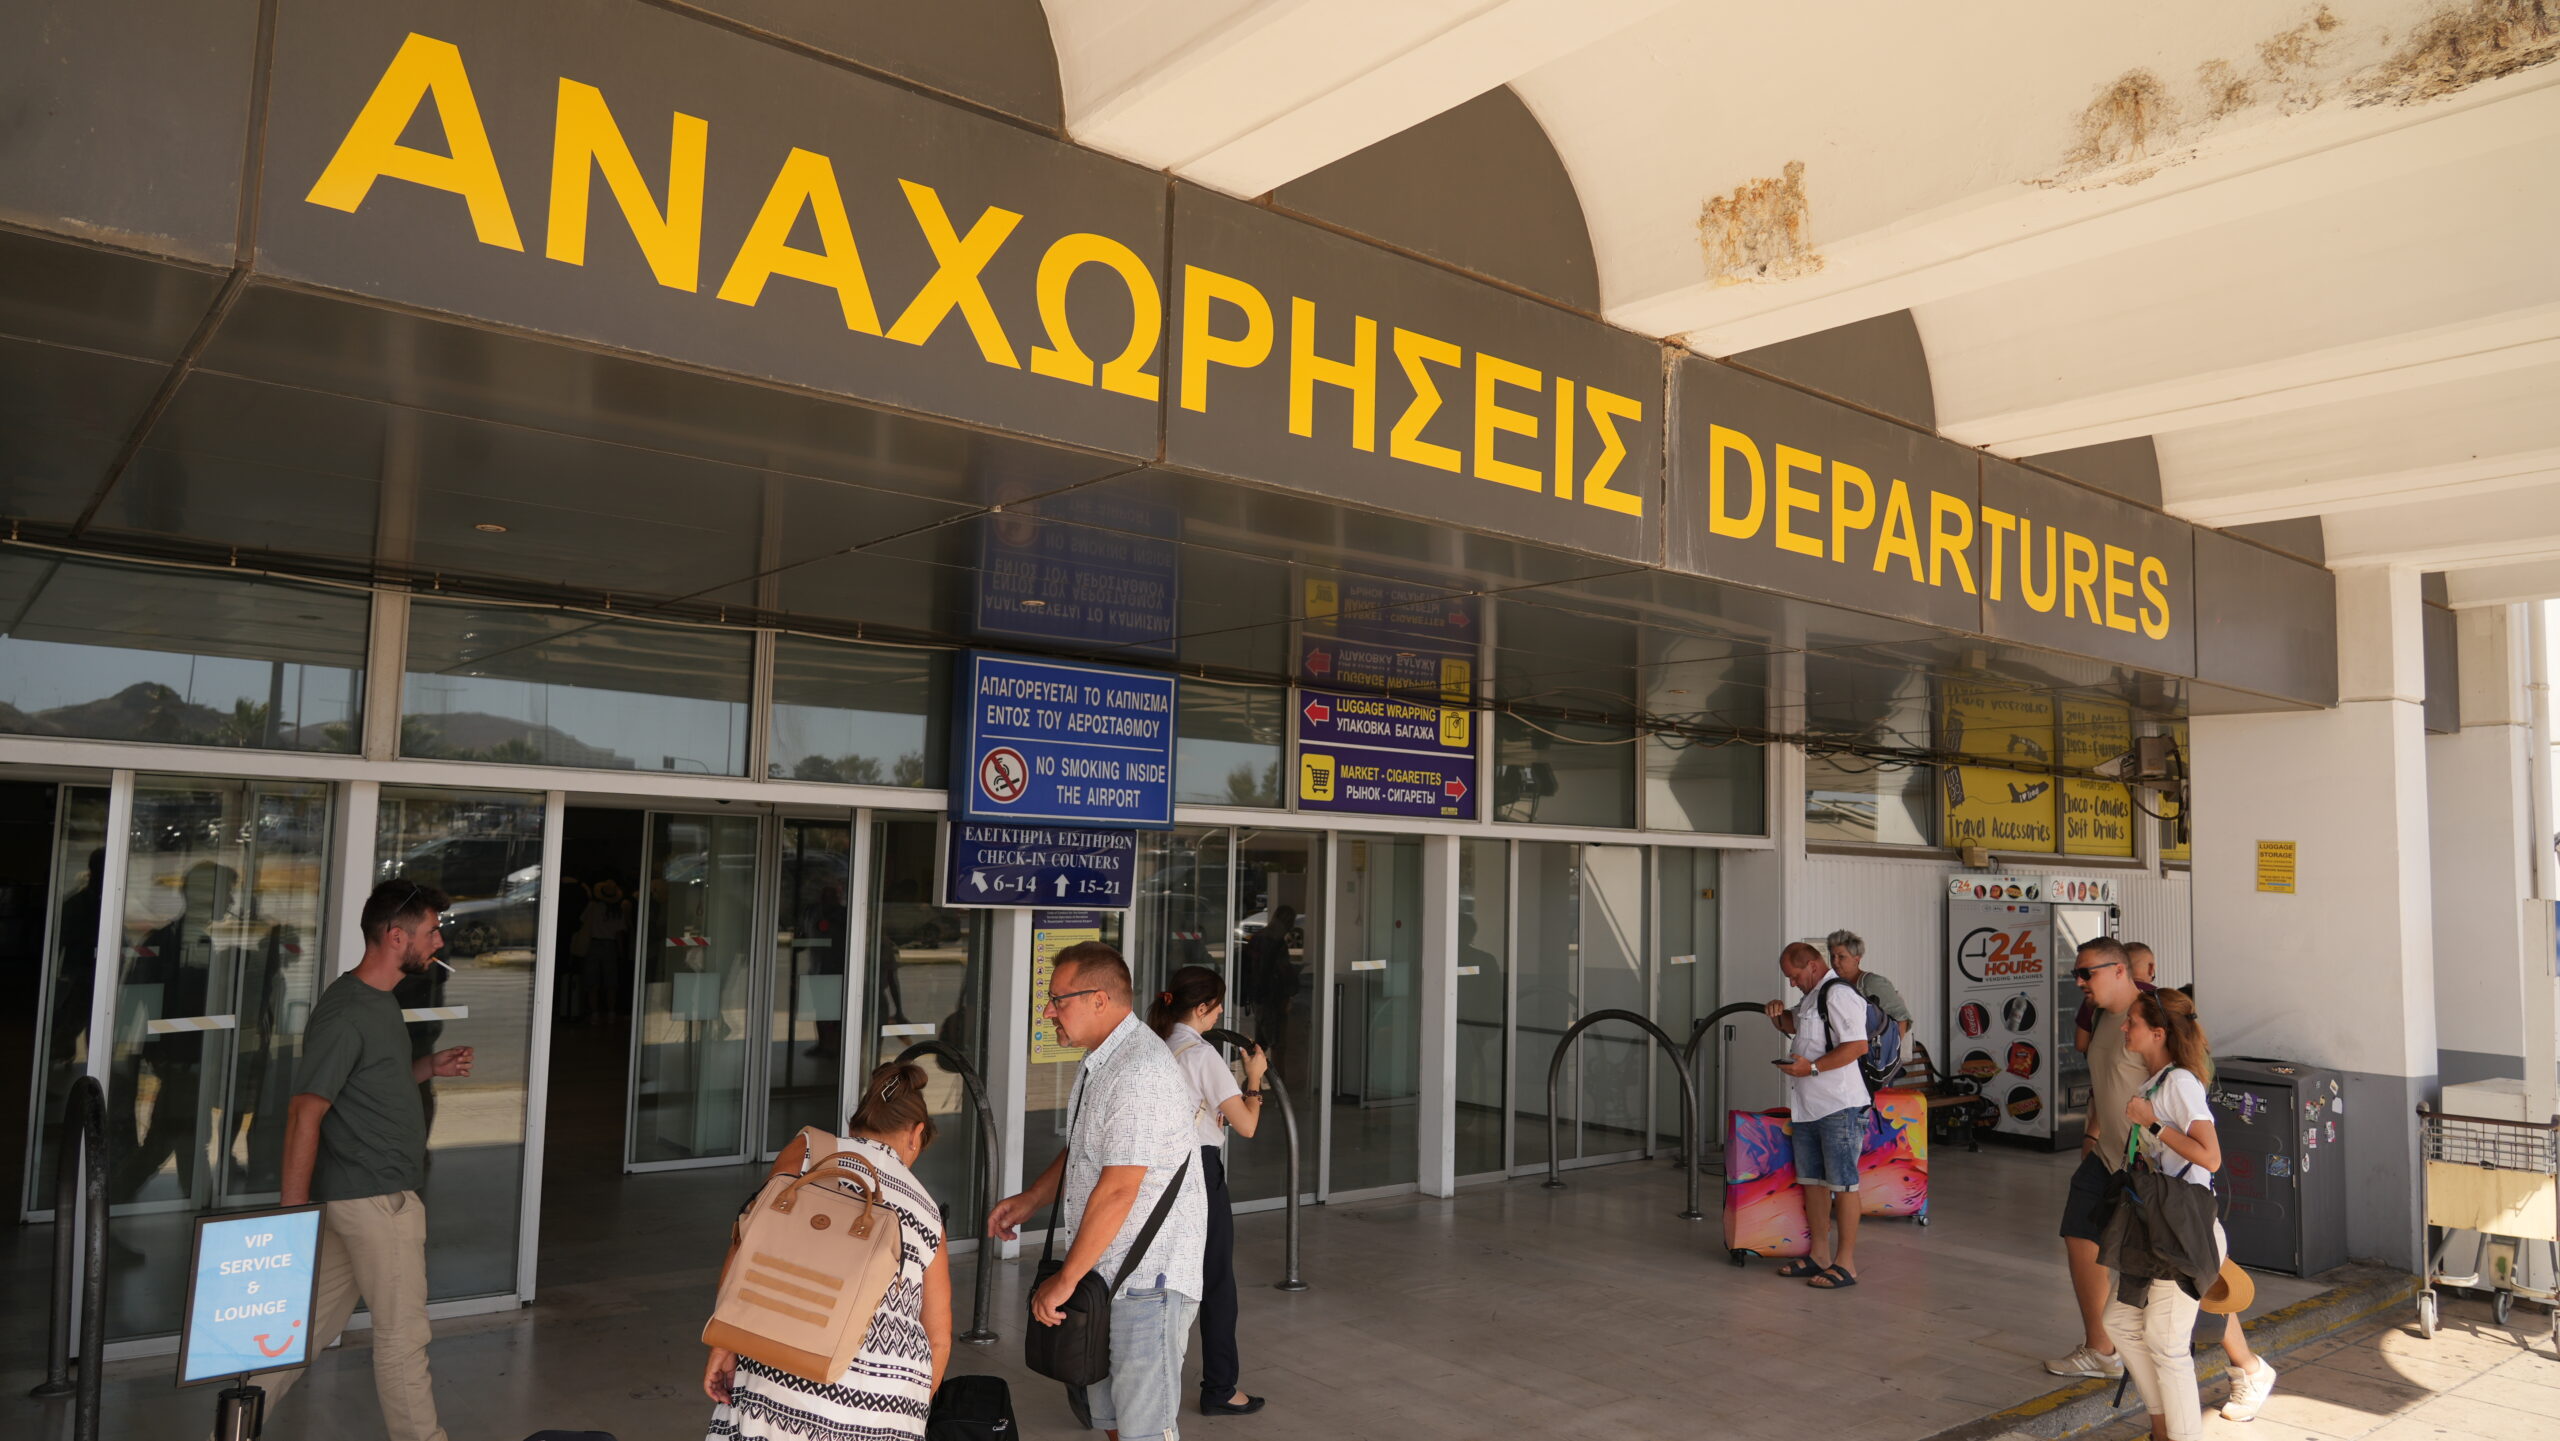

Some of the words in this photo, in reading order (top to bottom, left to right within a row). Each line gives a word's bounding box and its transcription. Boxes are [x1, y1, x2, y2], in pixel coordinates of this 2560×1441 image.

[305, 31, 1642, 517] ΑΝΑΧΩΡΗΣΕΙΣ
[1709, 423, 2170, 641] DEPARTURES
[980, 676, 1078, 705] ΑΠΑΓΟΡΕΥΕΤΑΙ
[1084, 686, 1101, 706] ΤΟ
[1106, 689, 1169, 713] ΚΑΠΝΙΣΜΑ
[1336, 698, 1385, 716] LUGGAGE
[1387, 705, 1436, 722] WRAPPING
[986, 705, 1030, 727] ΕΝΤΟΣ
[1037, 709, 1062, 730] ΤΟΥ
[1067, 713, 1160, 739] ΑΕΡΟΣΤΑΘΜΟΥ
[1337, 718, 1391, 736] УПАКОВКА
[1395, 723, 1435, 740] БАГАЖА
[1036, 756, 1055, 776] NO
[1061, 757, 1120, 780] SMOKING
[1126, 762, 1166, 783] INSIDE
[1340, 765, 1380, 780] MARKET
[1386, 769, 1442, 786] CIGARETTES
[1056, 785, 1081, 805] THE
[1087, 787, 1141, 808] AIRPORT
[1346, 785, 1381, 800] РЫНОК
[1387, 788, 1436, 804] СИГАРЕТЫ
[2094, 795, 2129, 819] Candies
[965, 826, 1053, 845] ΕΛΕΓΚΤΗΡΙΑ
[1058, 831, 1133, 850] ΕΙΣΙΤΗΡΙΩΝ
[1947, 814, 1986, 839] Travel
[1992, 816, 2051, 842] Accessories
[2068, 816, 2088, 839] Soft
[2093, 818, 2124, 840] Drinks
[977, 849, 1046, 866] CHECK-IN
[1051, 853, 1120, 869] COUNTERS
[2260, 851, 2293, 859] STORAGE
[1957, 880, 1970, 889] 24
[1988, 930, 2037, 962] 24
[1984, 959, 2043, 976] HOURS
[244, 1233, 274, 1248] VIP
[219, 1253, 292, 1276] SERVICE
[247, 1281, 260, 1295] &
[214, 1299, 288, 1322] LOUNGE
